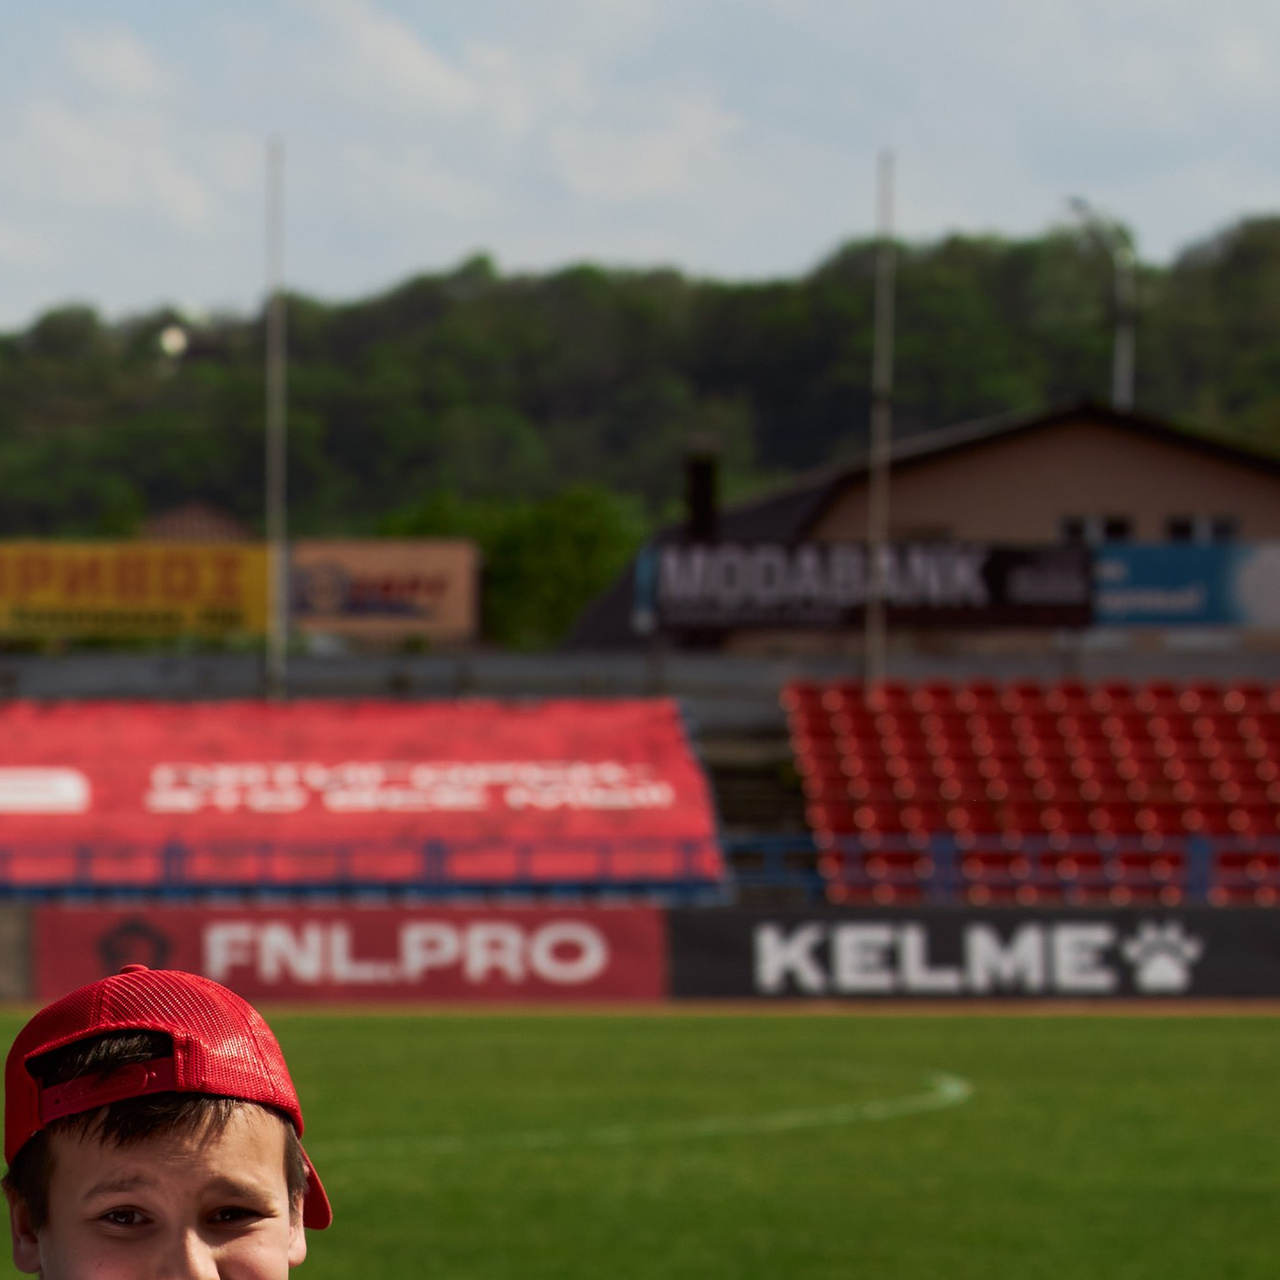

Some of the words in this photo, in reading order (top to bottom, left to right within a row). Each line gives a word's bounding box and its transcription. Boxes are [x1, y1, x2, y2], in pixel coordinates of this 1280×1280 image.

[658, 544, 986, 604] MODABANK
[203, 920, 610, 984] FNL.PRO
[754, 921, 1116, 994] KELME
